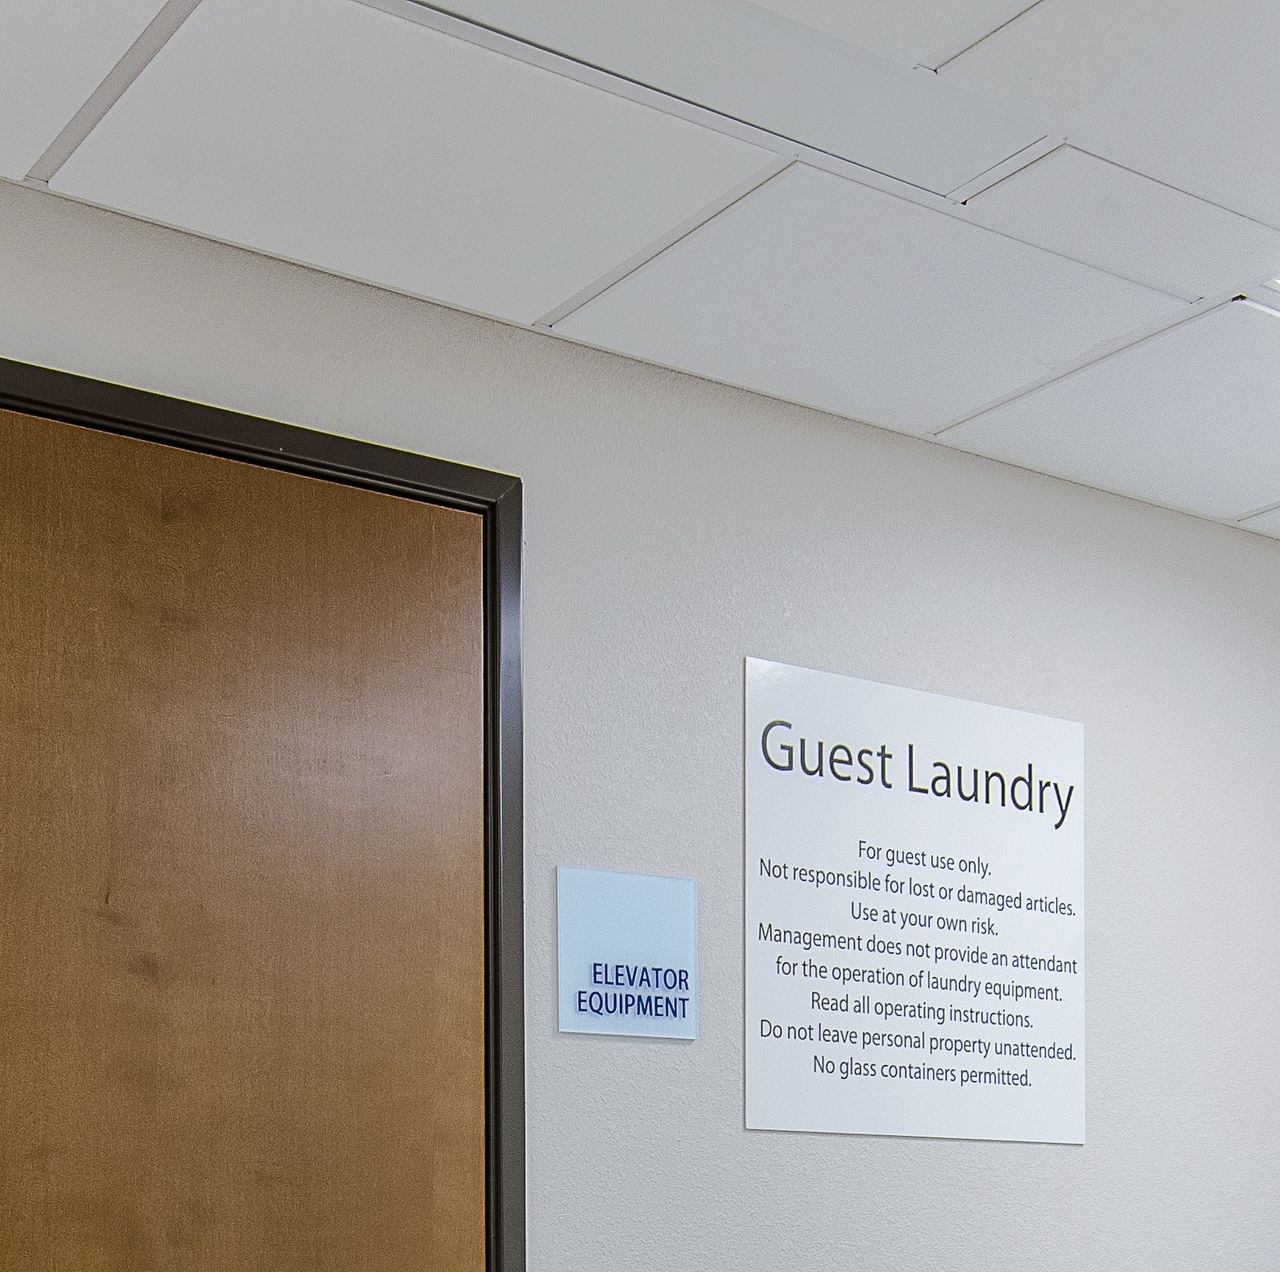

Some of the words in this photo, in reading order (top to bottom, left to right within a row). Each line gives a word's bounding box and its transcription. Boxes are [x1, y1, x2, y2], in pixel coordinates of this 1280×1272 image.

[761, 719, 893, 789] Guest
[908, 743, 1074, 830] Laundry
[858, 840, 882, 860] For
[886, 849, 926, 867] guest
[930, 854, 955, 870] use
[958, 856, 991, 879] only.
[760, 857, 788, 880] Not
[793, 866, 881, 891] responsible
[885, 873, 905, 894] for
[909, 877, 934, 899] lost
[938, 885, 953, 900] or
[957, 884, 1022, 911] damaged
[1026, 896, 1075, 916] articles.
[851, 901, 878, 922] Use
[882, 908, 896, 925] at
[900, 911, 933, 930] your
[936, 915, 967, 933] own
[971, 917, 998, 936] risk.
[758, 922, 862, 951] Management
[866, 934, 902, 956] does
[906, 942, 931, 959] not
[934, 946, 988, 965] provide
[991, 951, 1008, 967] an
[1011, 953, 1077, 975] attendant
[593, 963, 688, 990] ELEVATOR
[776, 955, 798, 976] for
[802, 958, 827, 979] the
[831, 966, 905, 986] operation
[909, 970, 924, 988] of
[927, 970, 981, 998] laundry
[984, 980, 1062, 1001] equipment.
[578, 990, 689, 1018] EQUIPMENT
[811, 991, 849, 1012] Read
[853, 995, 870, 1014] all
[874, 1001, 945, 1025] operating
[949, 1004, 1034, 1028] instructions.
[760, 1019, 783, 1039] Do
[787, 1025, 814, 1041] not
[818, 1022, 858, 1044] leave
[862, 1031, 925, 1049] personal
[929, 1036, 991, 1059] property
[994, 1041, 1076, 1061] unattended.
[813, 1055, 835, 1074] No
[839, 1056, 877, 1080] glass
[880, 1063, 956, 1082] containers
[960, 1068, 1032, 1087] permitted.
